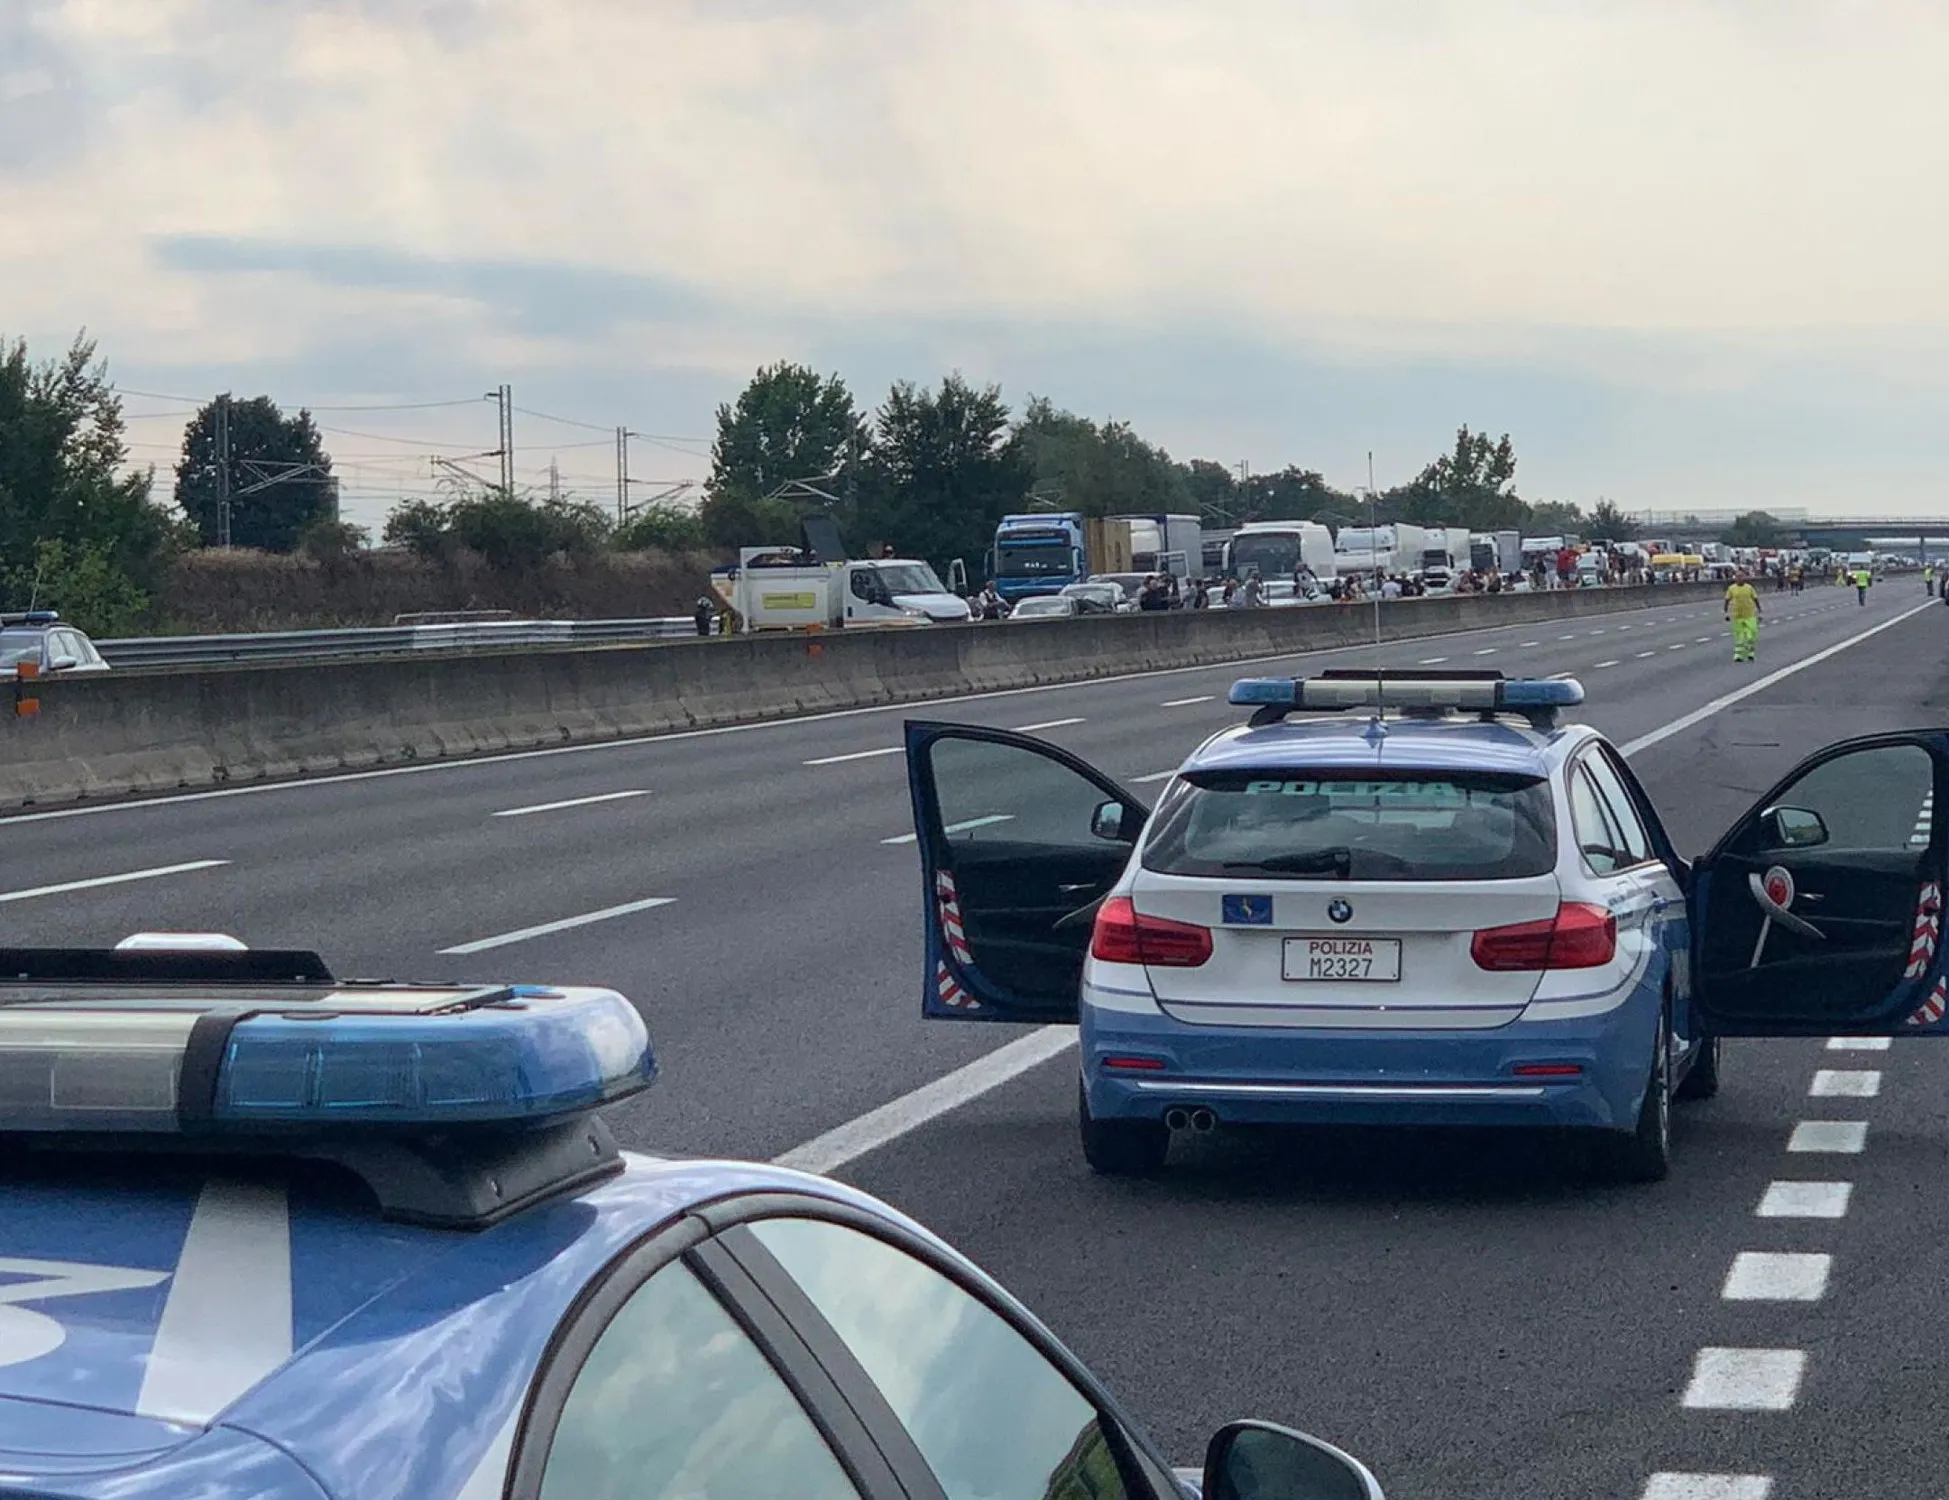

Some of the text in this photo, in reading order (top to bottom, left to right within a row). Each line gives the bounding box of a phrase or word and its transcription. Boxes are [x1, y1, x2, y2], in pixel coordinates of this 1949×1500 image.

[1245, 781, 1459, 796] POLIZIA
[1309, 941, 1373, 955] POLIZIA
[1310, 958, 1373, 977] M2327
